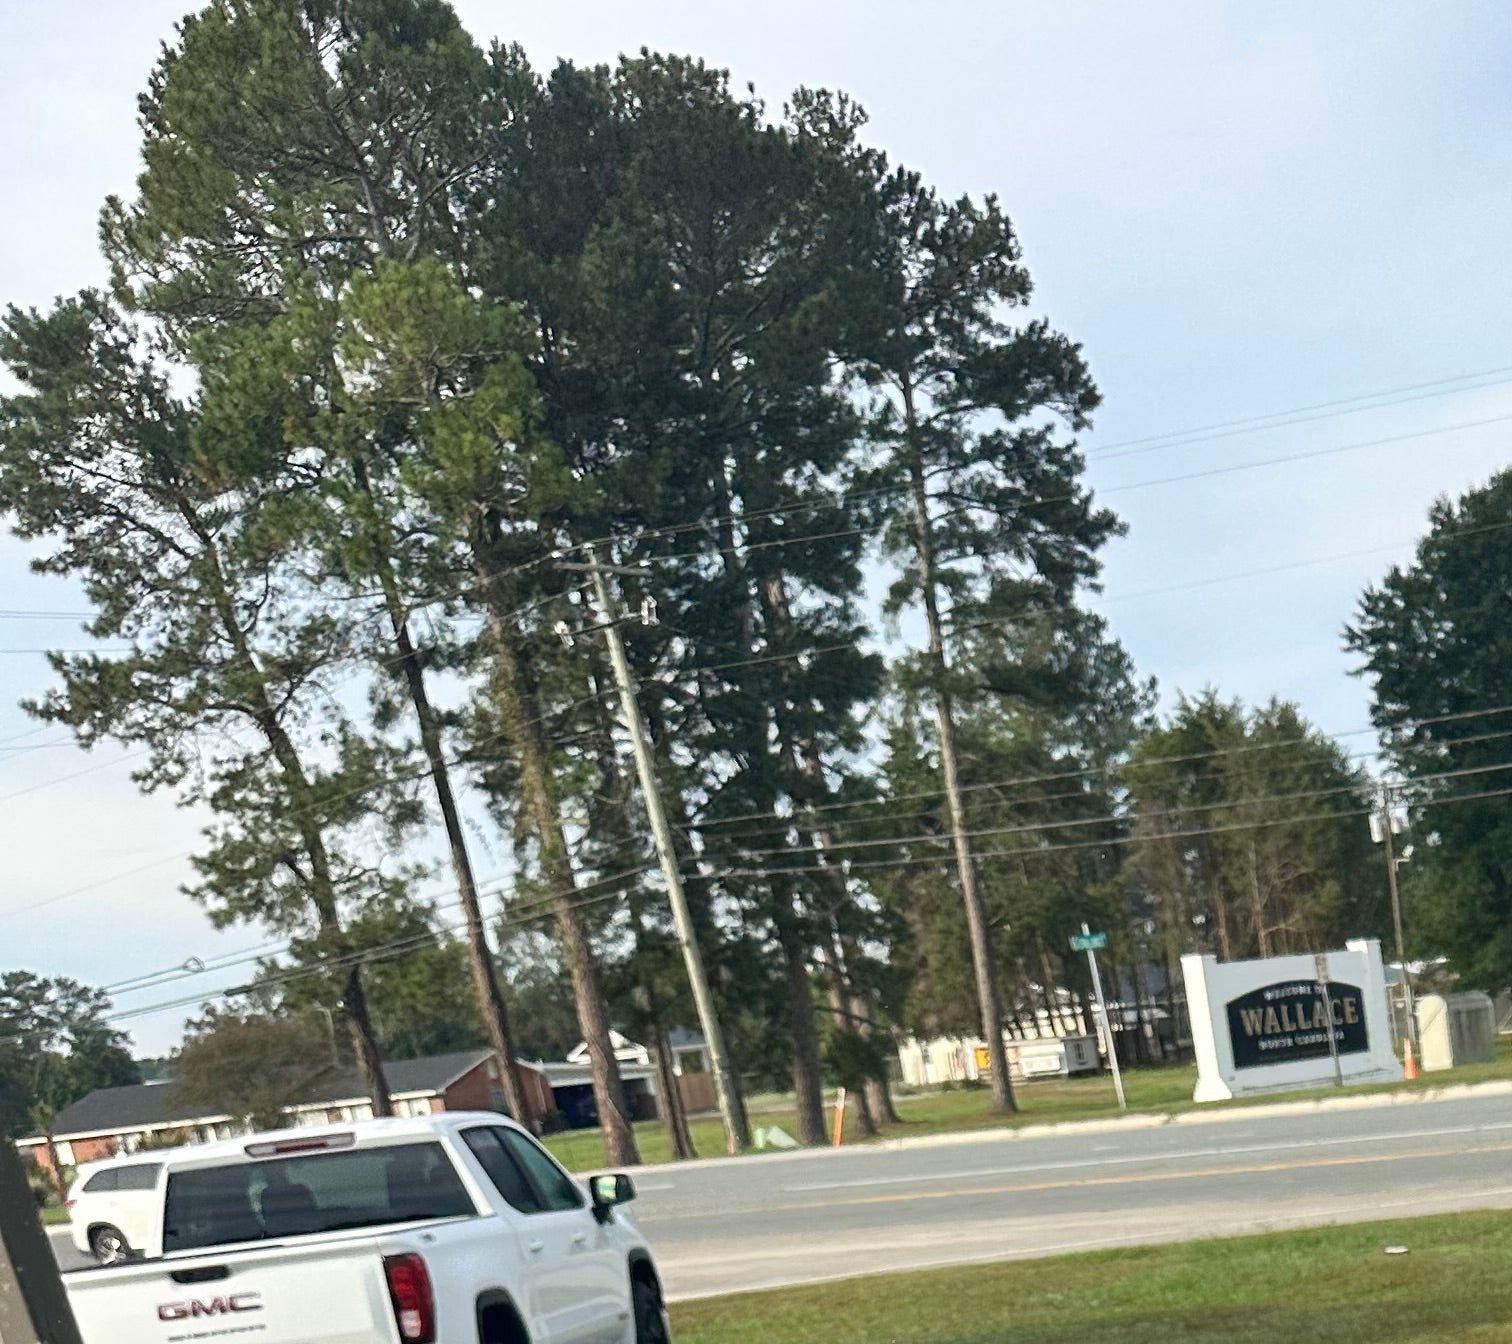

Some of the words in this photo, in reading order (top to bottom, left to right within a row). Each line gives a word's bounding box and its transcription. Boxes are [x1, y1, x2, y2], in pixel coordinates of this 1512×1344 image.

[1239, 996, 1359, 1037] WALLACE
[1295, 1030, 1345, 1047] CAROLNA
[158, 1291, 262, 1321] GMC
